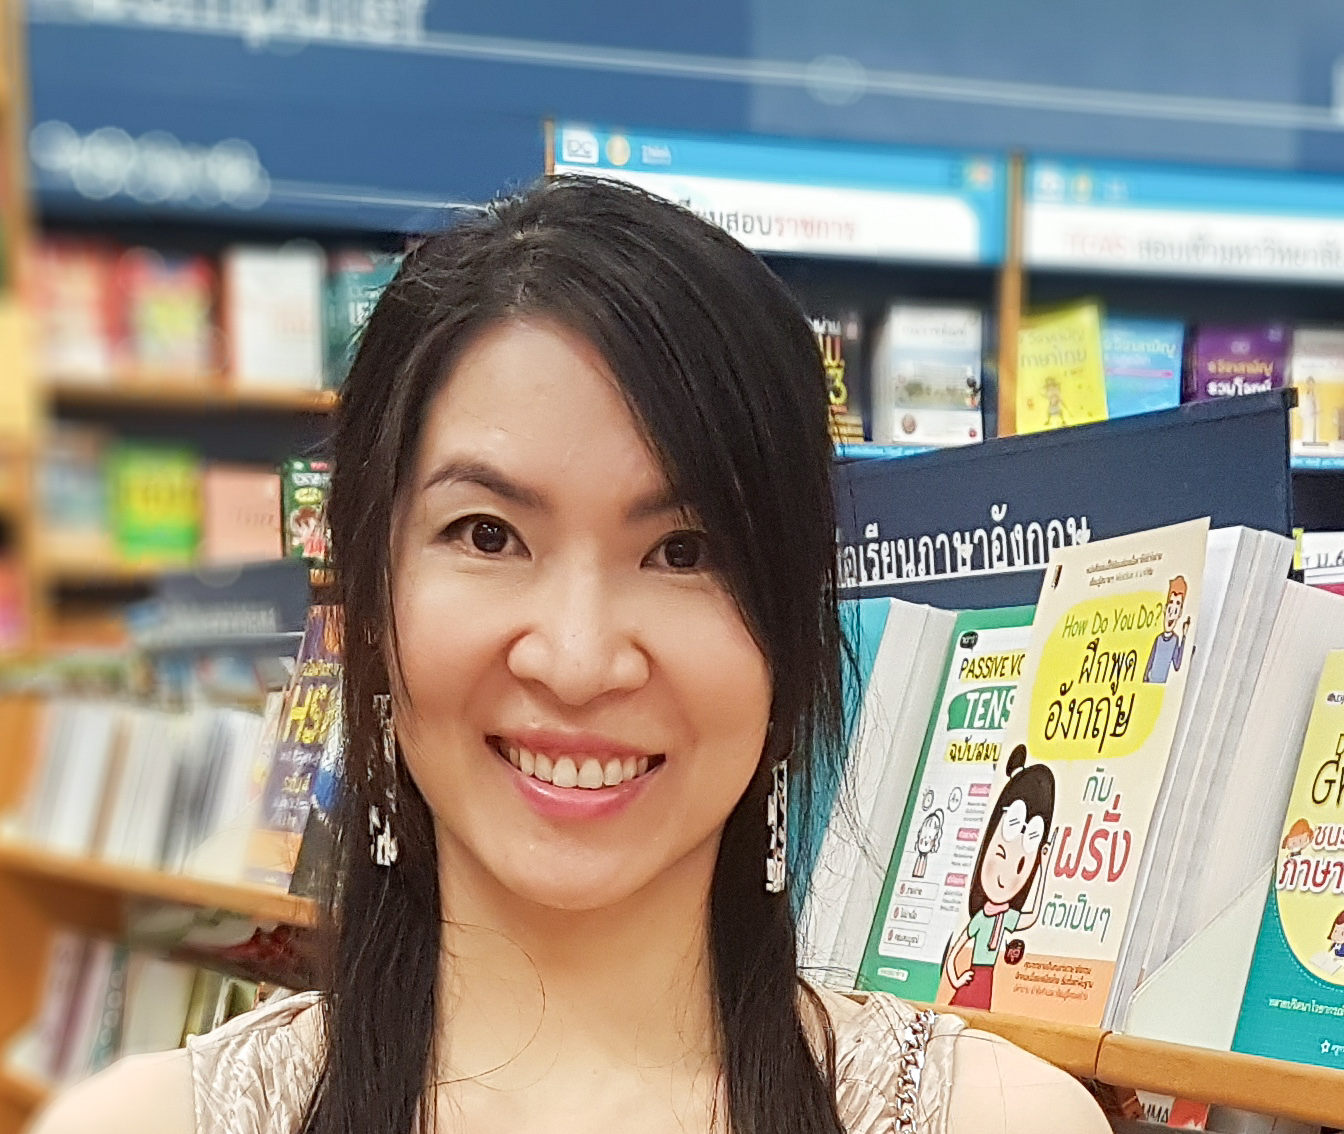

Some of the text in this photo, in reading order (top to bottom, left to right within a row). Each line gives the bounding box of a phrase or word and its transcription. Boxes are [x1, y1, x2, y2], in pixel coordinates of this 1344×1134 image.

[1062, 601, 1163, 638] How Do You Do?
[958, 654, 1009, 680] PASSIVE
[1078, 637, 1138, 696] ฝึกพูด
[1044, 680, 1136, 754] อังกฤษ
[1082, 766, 1115, 802] กับ
[1054, 793, 1133, 884] ฝรั่ง
[1041, 893, 1112, 944] ตัวเป็นๆ
